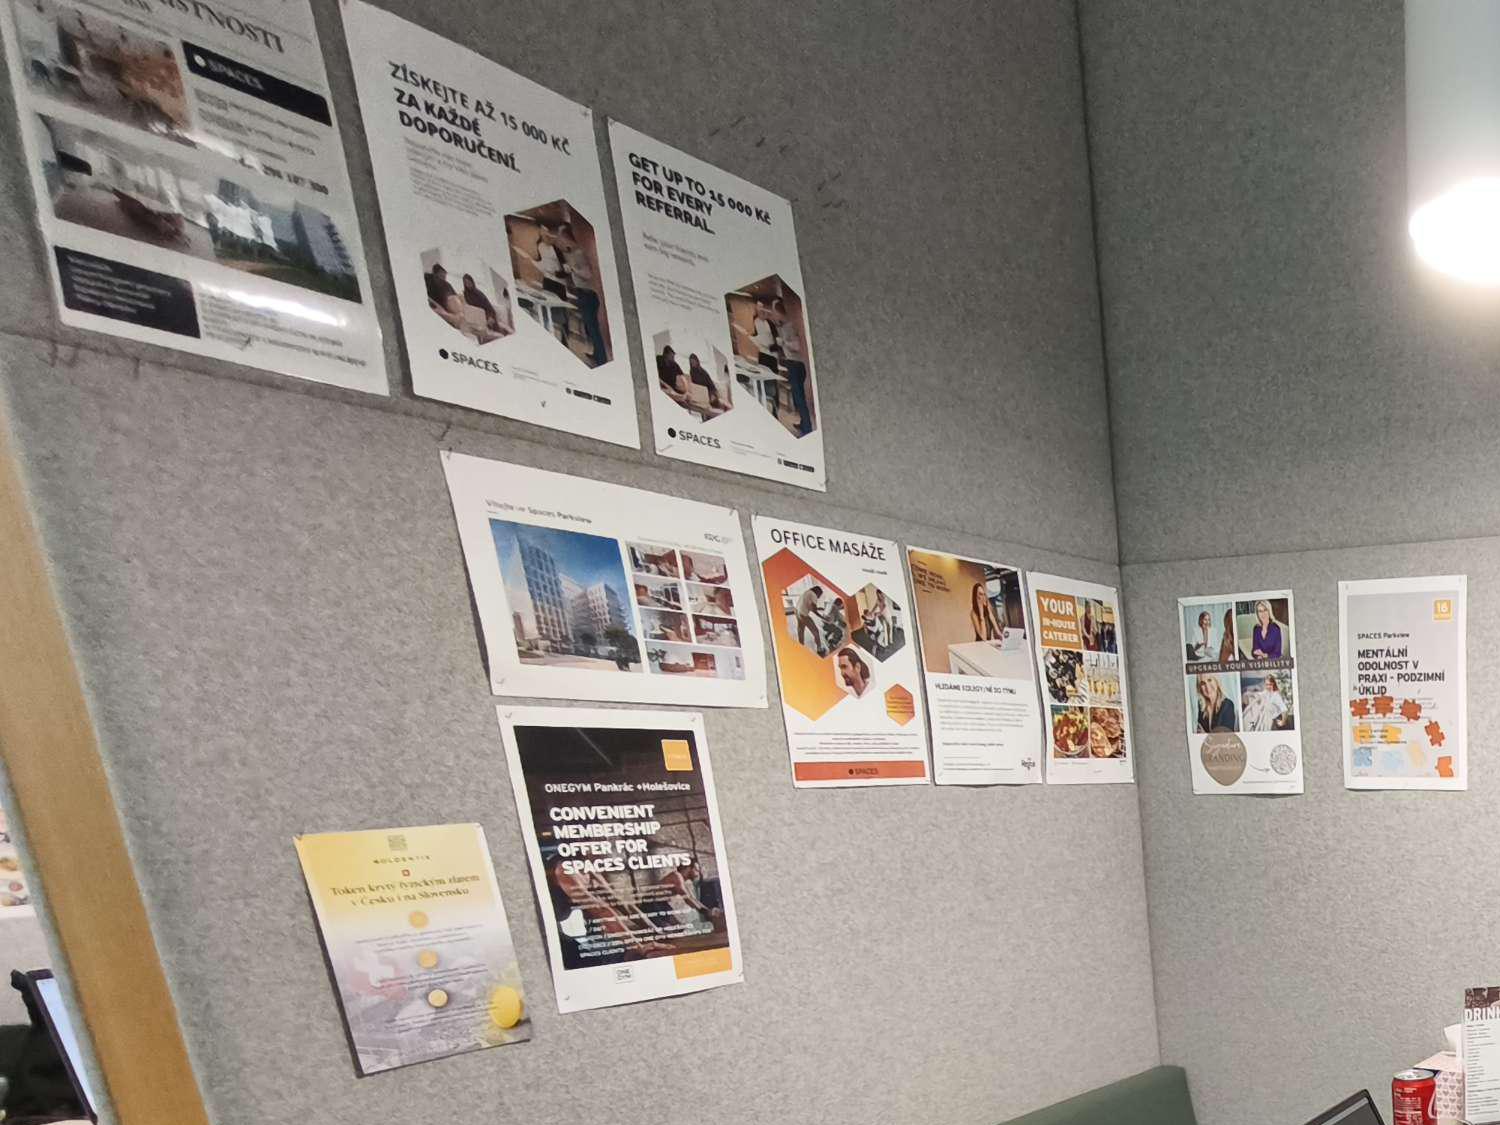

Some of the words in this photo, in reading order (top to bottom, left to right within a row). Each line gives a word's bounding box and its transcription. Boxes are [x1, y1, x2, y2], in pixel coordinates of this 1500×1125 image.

[389, 61, 469, 109] ZÍSKEJTE
[475, 100, 497, 121] AŽ
[500, 112, 518, 131] 15
[522, 121, 548, 144] 000
[394, 88, 420, 111] ZA
[424, 100, 482, 136] KAŽDÉ
[628, 152, 658, 176] GET
[662, 166, 684, 186] UP
[685, 176, 706, 196] TO
[708, 190, 727, 208] 15
[727, 197, 753, 217] 000
[632, 172, 664, 197] FOR
[667, 187, 713, 216] EVERY
[770, 528, 826, 551] OFFICE
[828, 538, 886, 561] MASÁŽE
[1040, 596, 1074, 616] YOUR
[1042, 630, 1078, 642] CATERER
[1357, 645, 1408, 659] MENTÁLNÍ
[1188, 663, 1222, 672] UPGRADE
[1225, 663, 1246, 671] YOUR
[1249, 660, 1291, 669] VISIBILITY
[1358, 660, 1409, 671] ODOLNOST
[1412, 660, 1420, 670] V
[1358, 673, 1388, 683] PRAXI
[1397, 670, 1445, 683] PODZIMNÍ
[1358, 684, 1387, 695] ÚKLID
[545, 783, 592, 793] ONEGYM
[594, 782, 634, 792] Pankrác
[550, 804, 655, 821] CONVENIENT
[553, 821, 661, 839] MEMBERSHIP
[557, 841, 612, 857] OFFER
[615, 838, 648, 854] FOR
[562, 857, 626, 875] SPACES
[628, 853, 692, 870] CLIENTS
